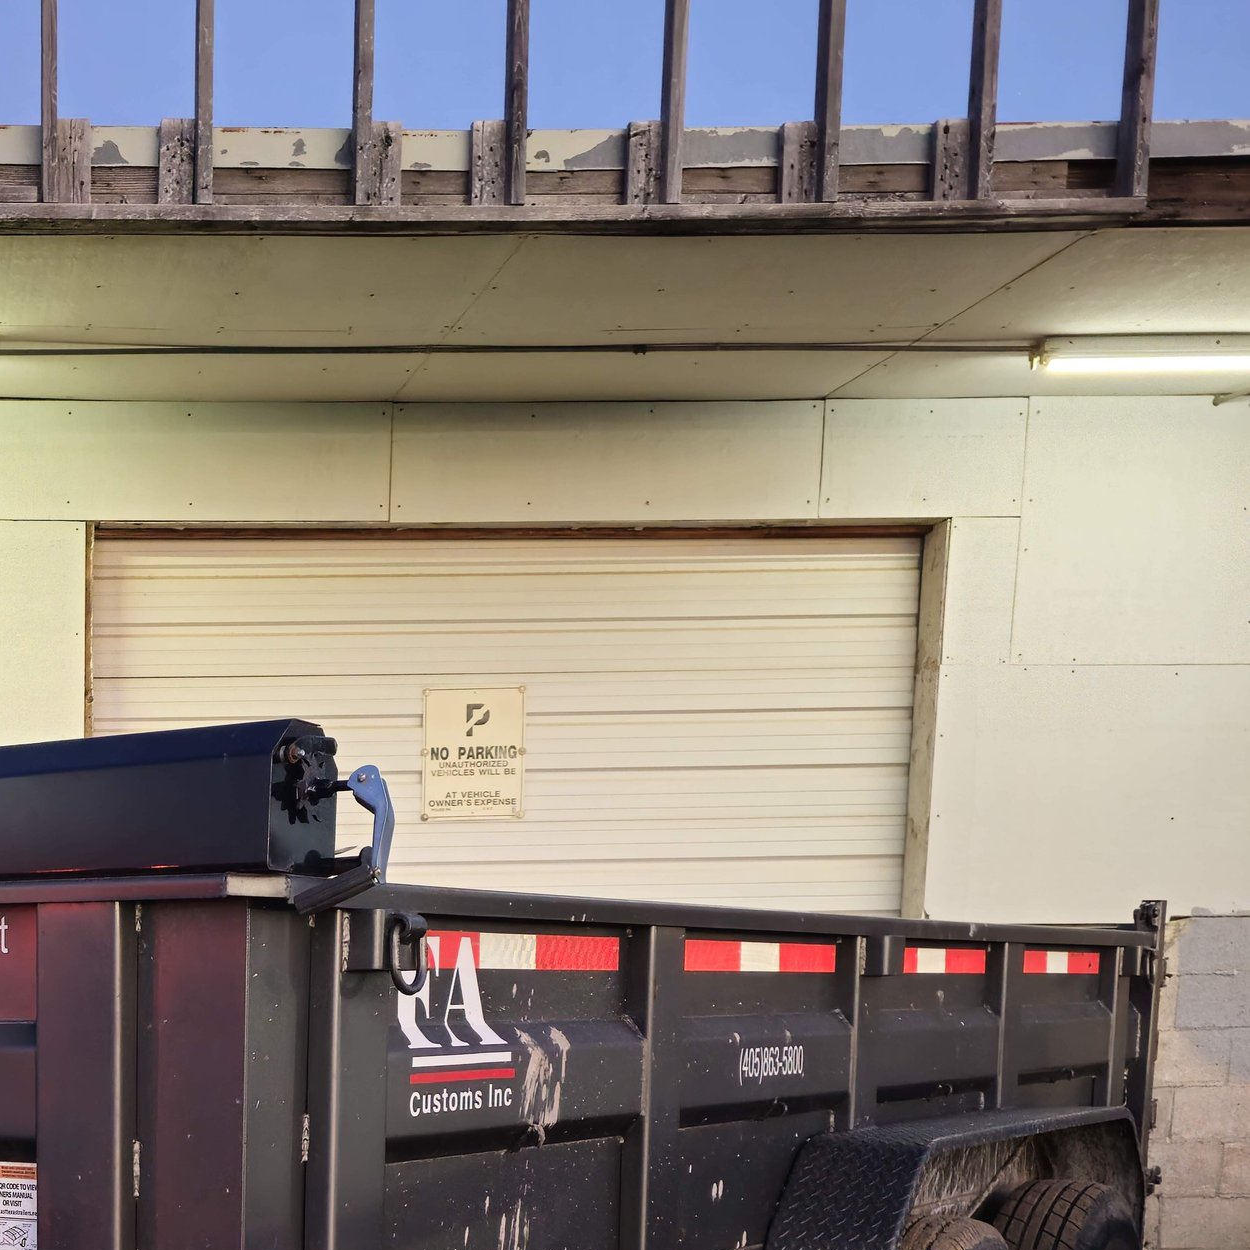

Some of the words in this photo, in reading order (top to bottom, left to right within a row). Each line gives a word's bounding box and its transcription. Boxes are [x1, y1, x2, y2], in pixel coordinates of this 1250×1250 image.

[430, 747, 449, 760] NO
[458, 745, 517, 760] PARKING
[438, 760, 509, 768] UNAUTHORIZED
[431, 768, 475, 776] VEHICLES
[461, 790, 500, 798] VEHICLE
[428, 799, 472, 807] OWNER'S
[474, 798, 517, 806] EXPENSE
[739, 1045, 804, 1086] (405)863-5800
[409, 1088, 483, 1117] Customs
[488, 1083, 512, 1108] Inc
